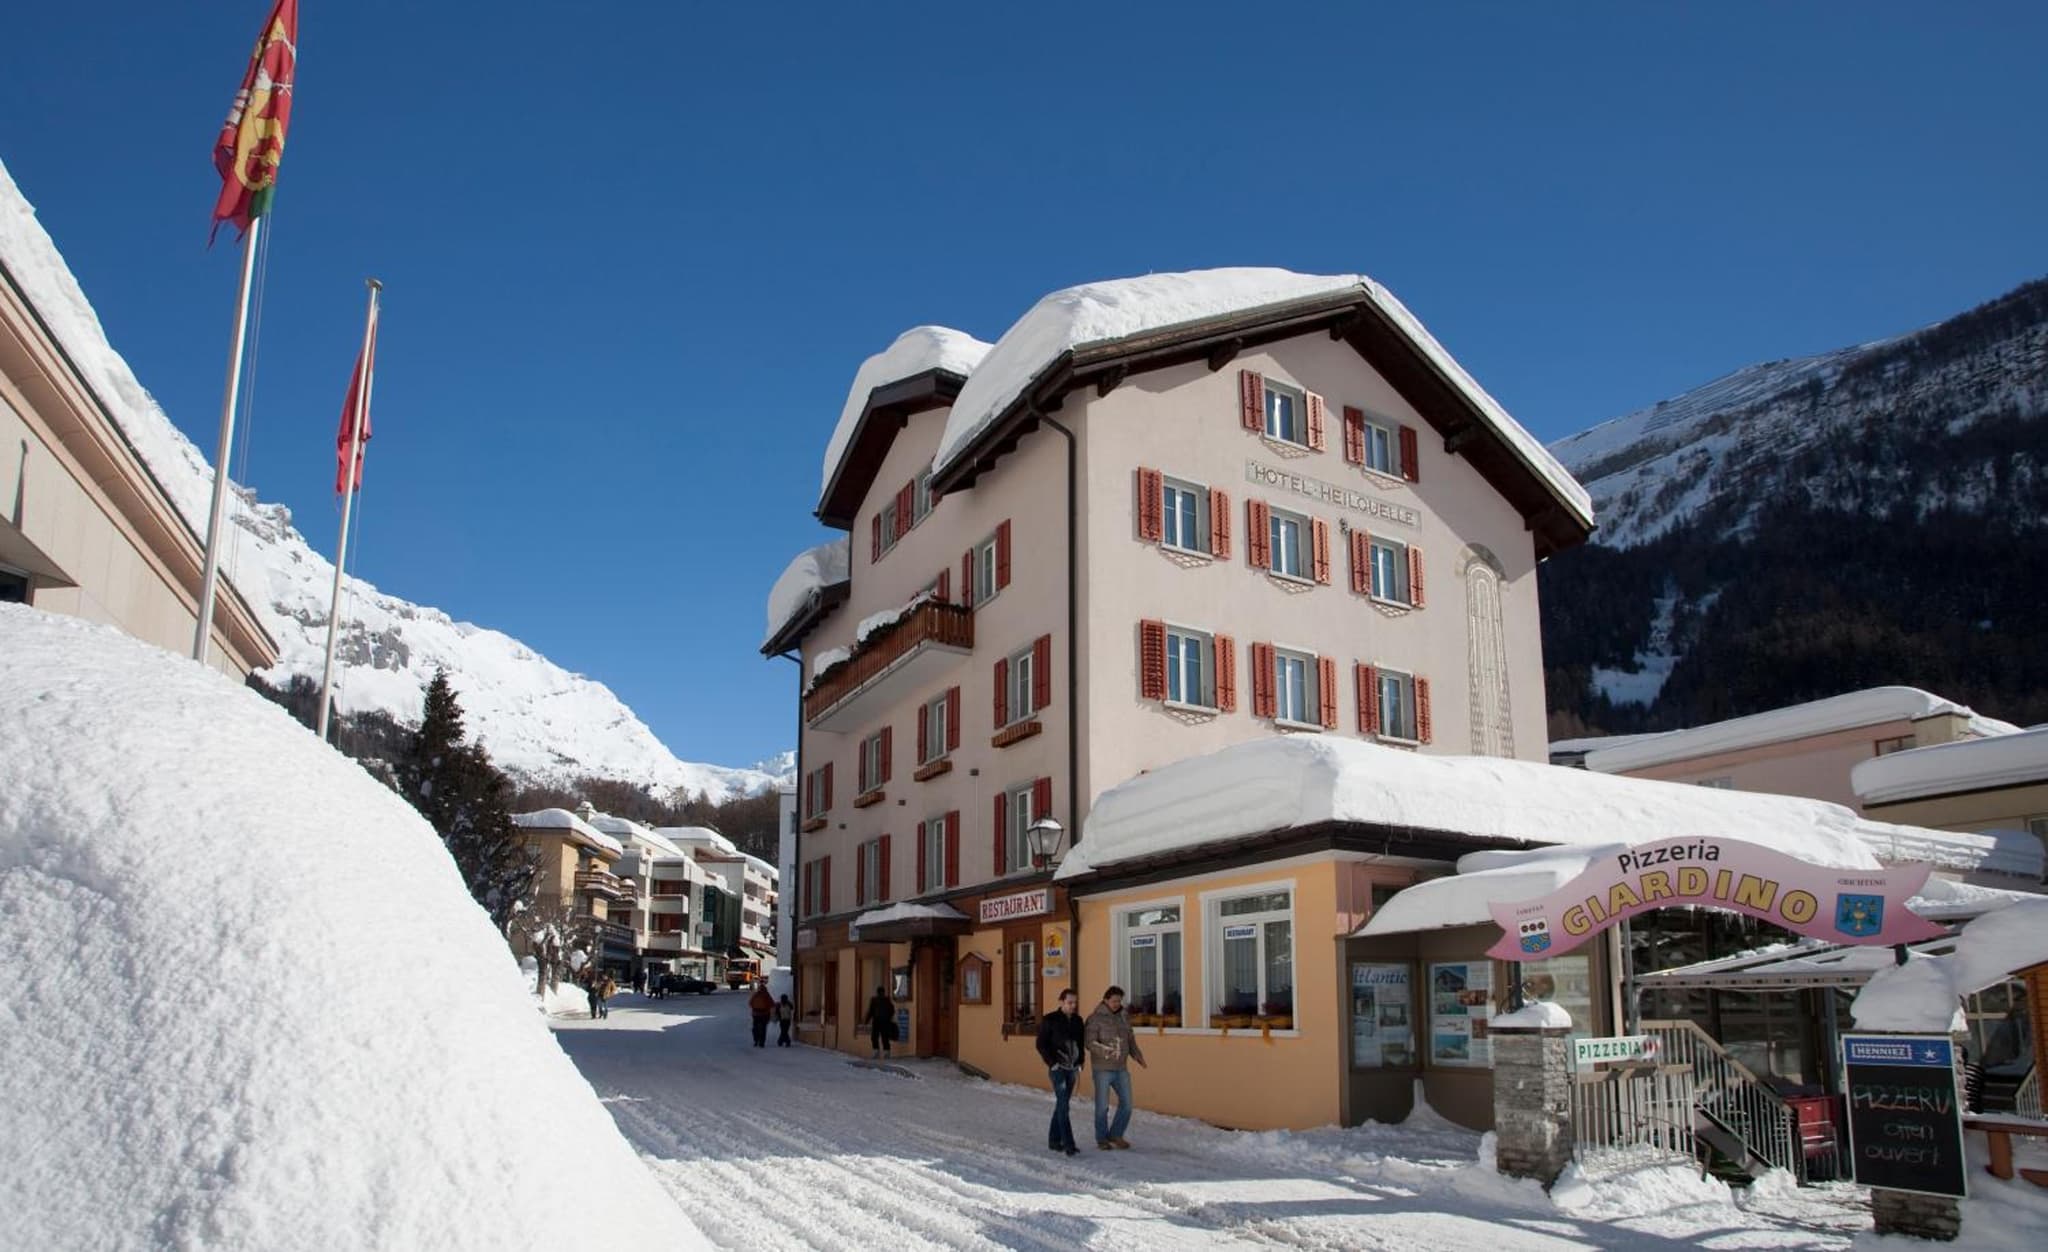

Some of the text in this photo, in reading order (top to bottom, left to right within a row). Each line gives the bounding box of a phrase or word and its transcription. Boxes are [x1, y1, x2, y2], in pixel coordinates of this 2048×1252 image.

[1255, 466, 1312, 496] HOTEL
[1617, 839, 1720, 874] Pizzeria
[982, 892, 1046, 920] RESTAURANT
[1562, 866, 1818, 936] GIARDINO
[1578, 1041, 1641, 1059] PIZZERIA
